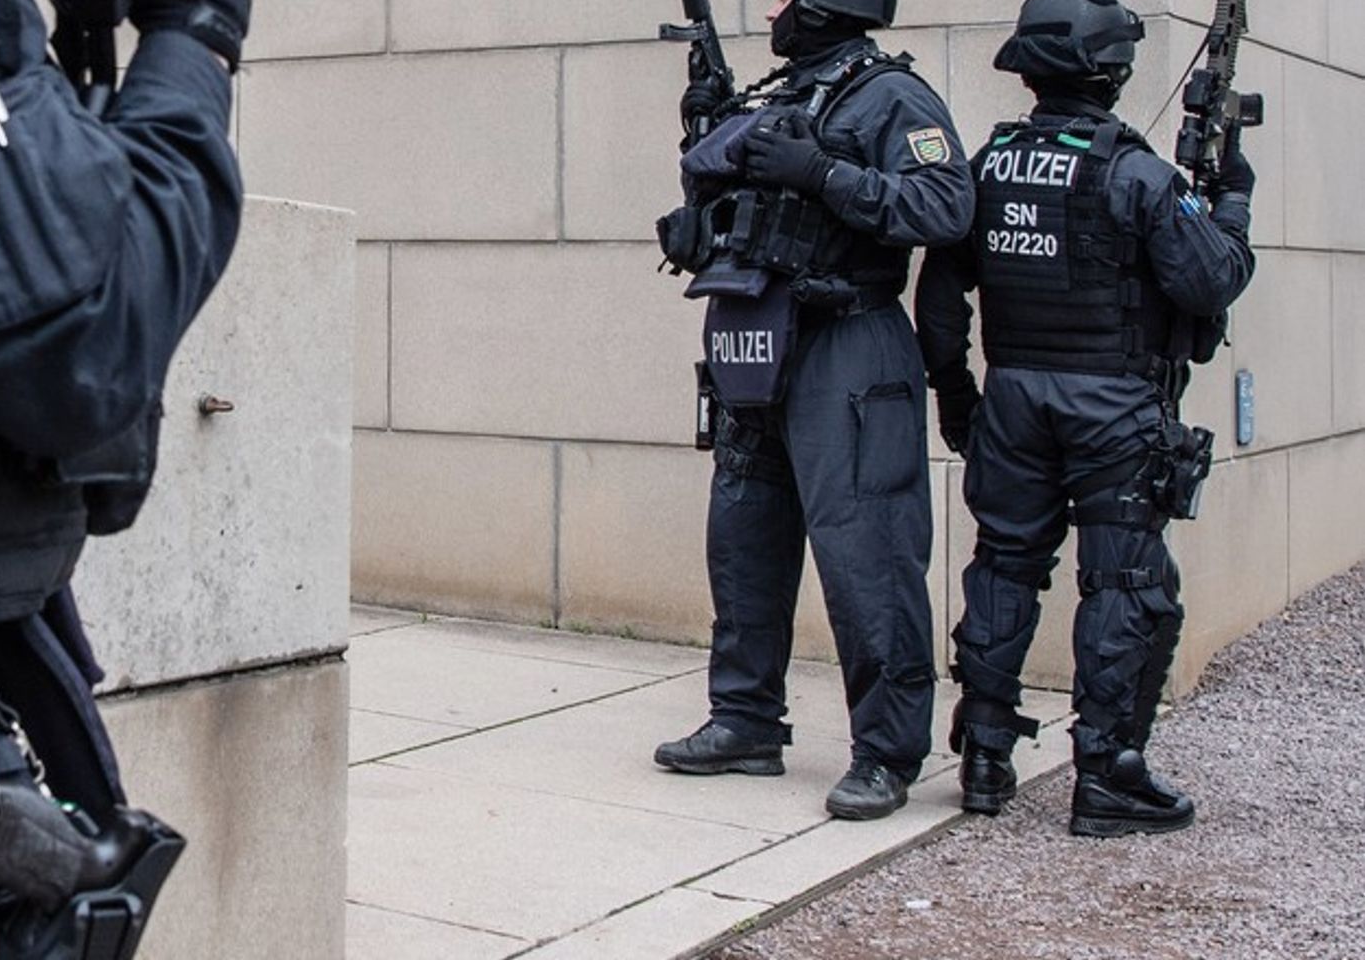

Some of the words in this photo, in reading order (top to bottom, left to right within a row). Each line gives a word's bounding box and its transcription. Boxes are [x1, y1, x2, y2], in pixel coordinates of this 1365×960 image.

[980, 149, 1078, 187] POLIZEI
[1003, 202, 1038, 227] SN
[987, 229, 1058, 257] 92/220
[712, 330, 773, 363] POLIZEI
